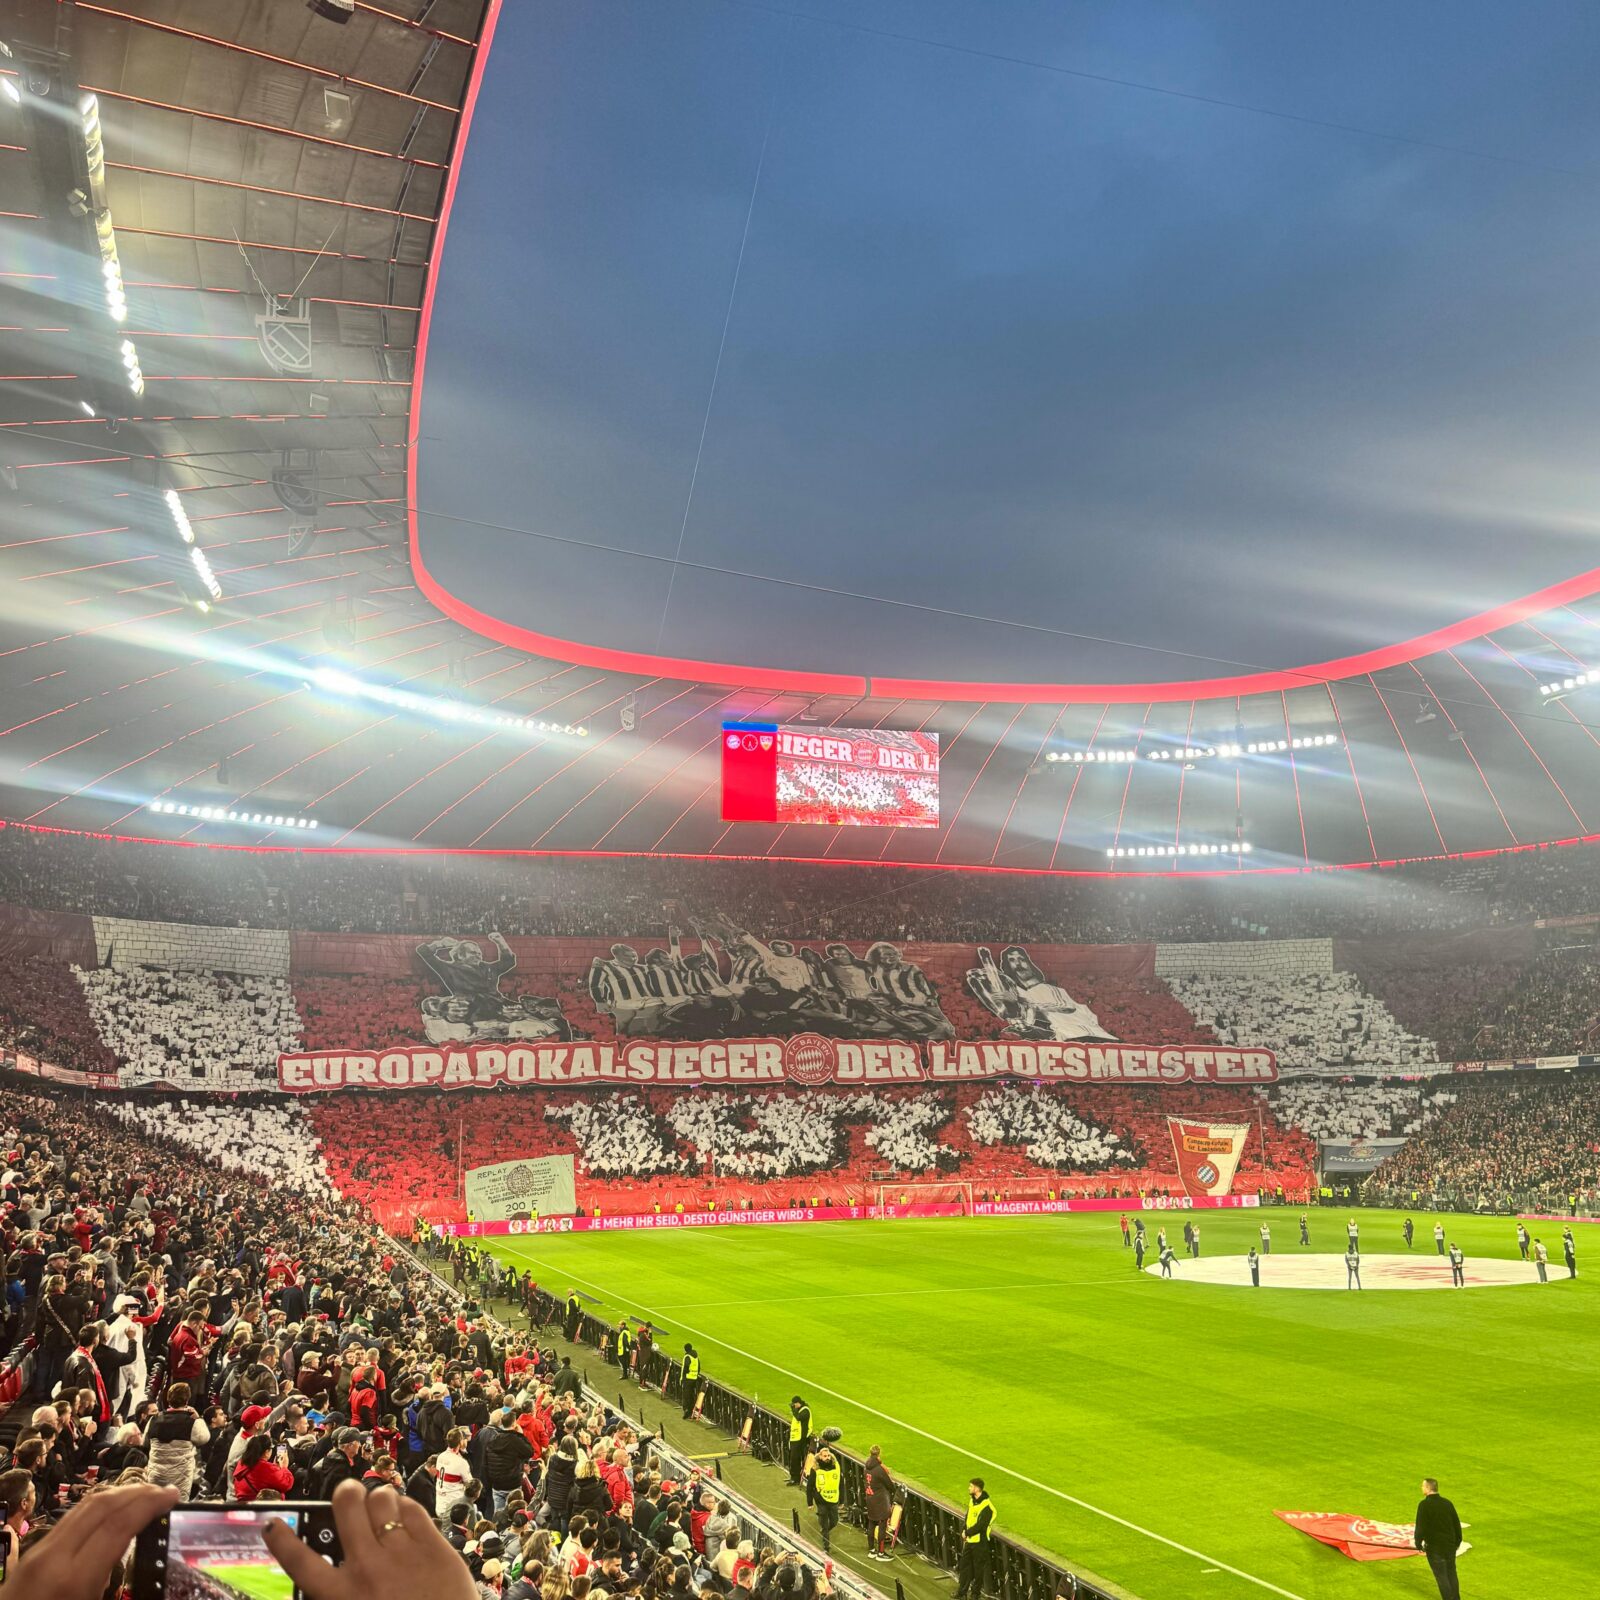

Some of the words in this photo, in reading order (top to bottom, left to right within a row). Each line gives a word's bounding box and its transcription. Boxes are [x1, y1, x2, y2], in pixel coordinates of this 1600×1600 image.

[878, 749, 917, 770] DER
[800, 1038, 831, 1056] BAYERN
[282, 1043, 785, 1087] EUROPAPOKALSIEGER
[836, 1043, 920, 1079] DER
[932, 1044, 1273, 1079] LANDESMEISTER
[477, 1167, 507, 1180] REPLAY
[505, 1201, 526, 1213] 200
[531, 1200, 538, 1208] F
[975, 1203, 991, 1213] MIT
[994, 1202, 1041, 1213] MAGENTA
[1044, 1202, 1071, 1212] MOBIL
[588, 1219, 601, 1229] JE
[603, 1217, 633, 1229] MEHR
[636, 1216, 654, 1227] IHR
[656, 1215, 682, 1227] SEID,
[684, 1213, 716, 1225] DESTO
[719, 1209, 775, 1224] GÜNSTIGER
